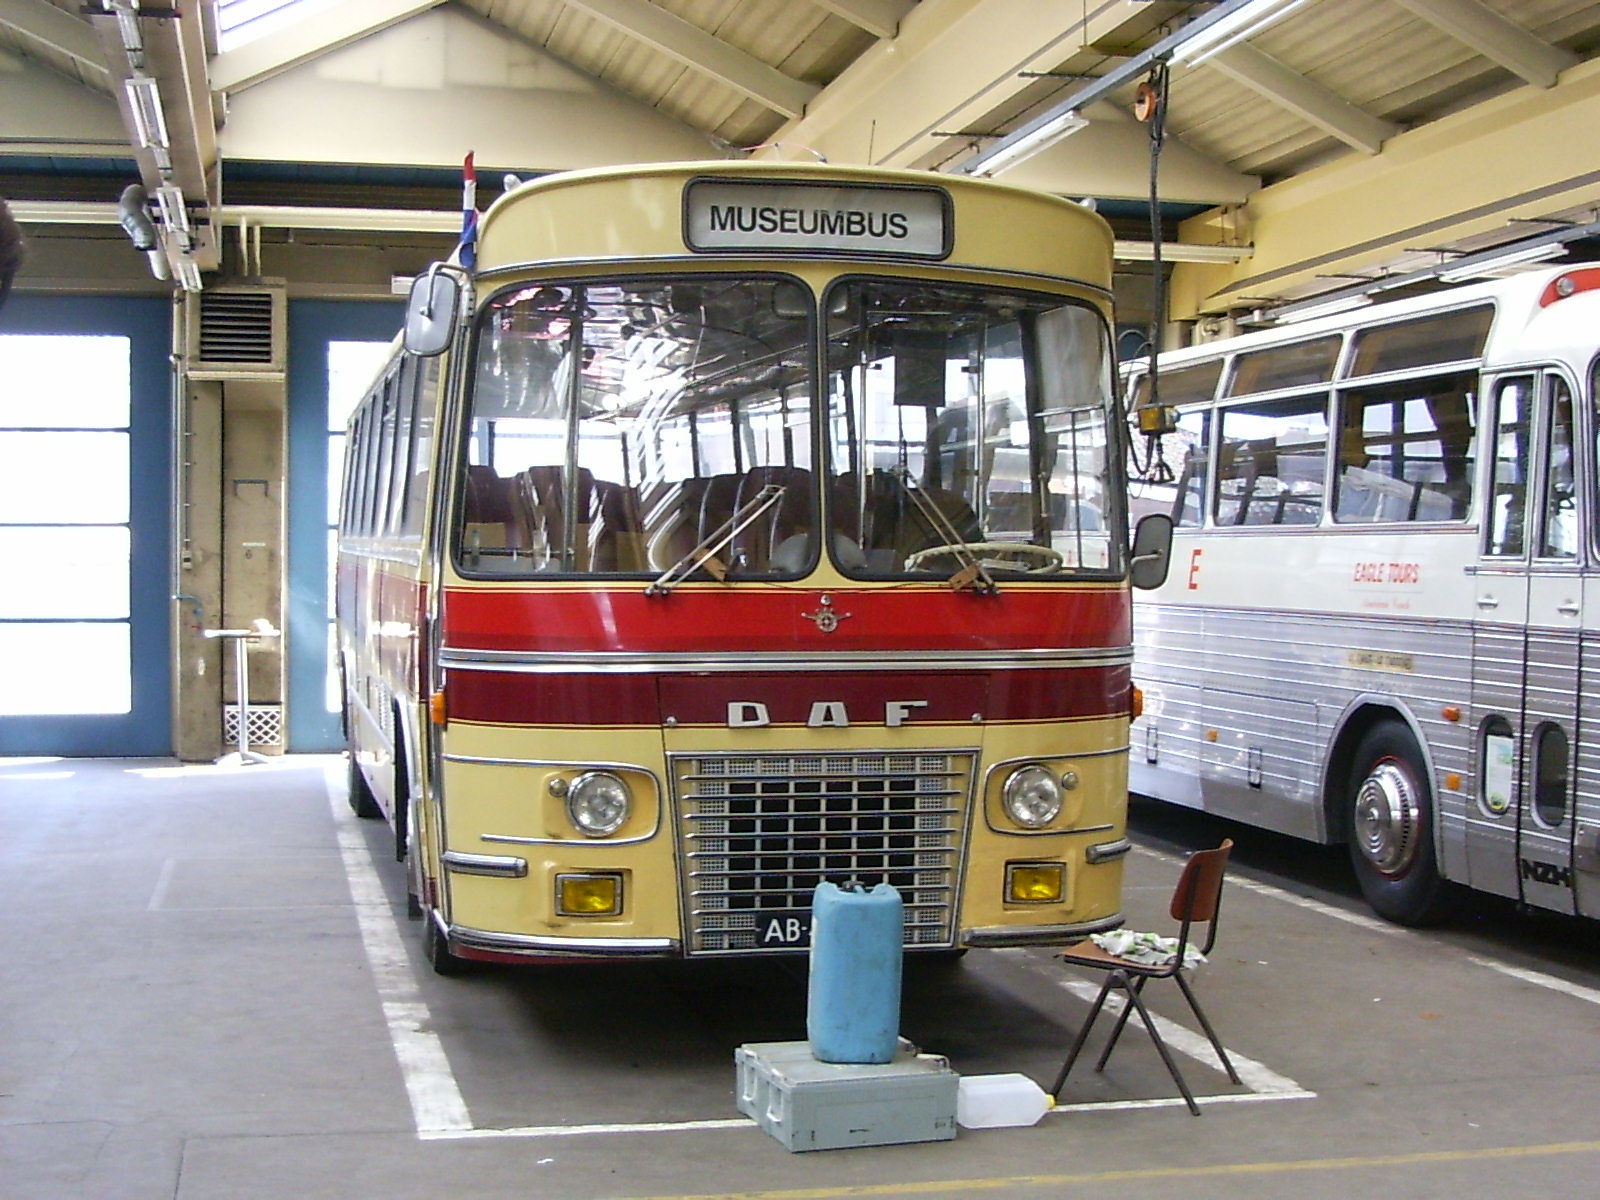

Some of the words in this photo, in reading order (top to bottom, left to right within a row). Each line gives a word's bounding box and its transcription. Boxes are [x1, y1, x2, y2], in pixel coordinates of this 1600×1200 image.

[710, 205, 909, 239] MUSEUMBUS
[1354, 562, 1384, 582] EAGLE
[1387, 563, 1419, 583] TOURS
[727, 700, 928, 728] DAF
[1520, 858, 1571, 888] NZH
[764, 918, 812, 943] AB-
